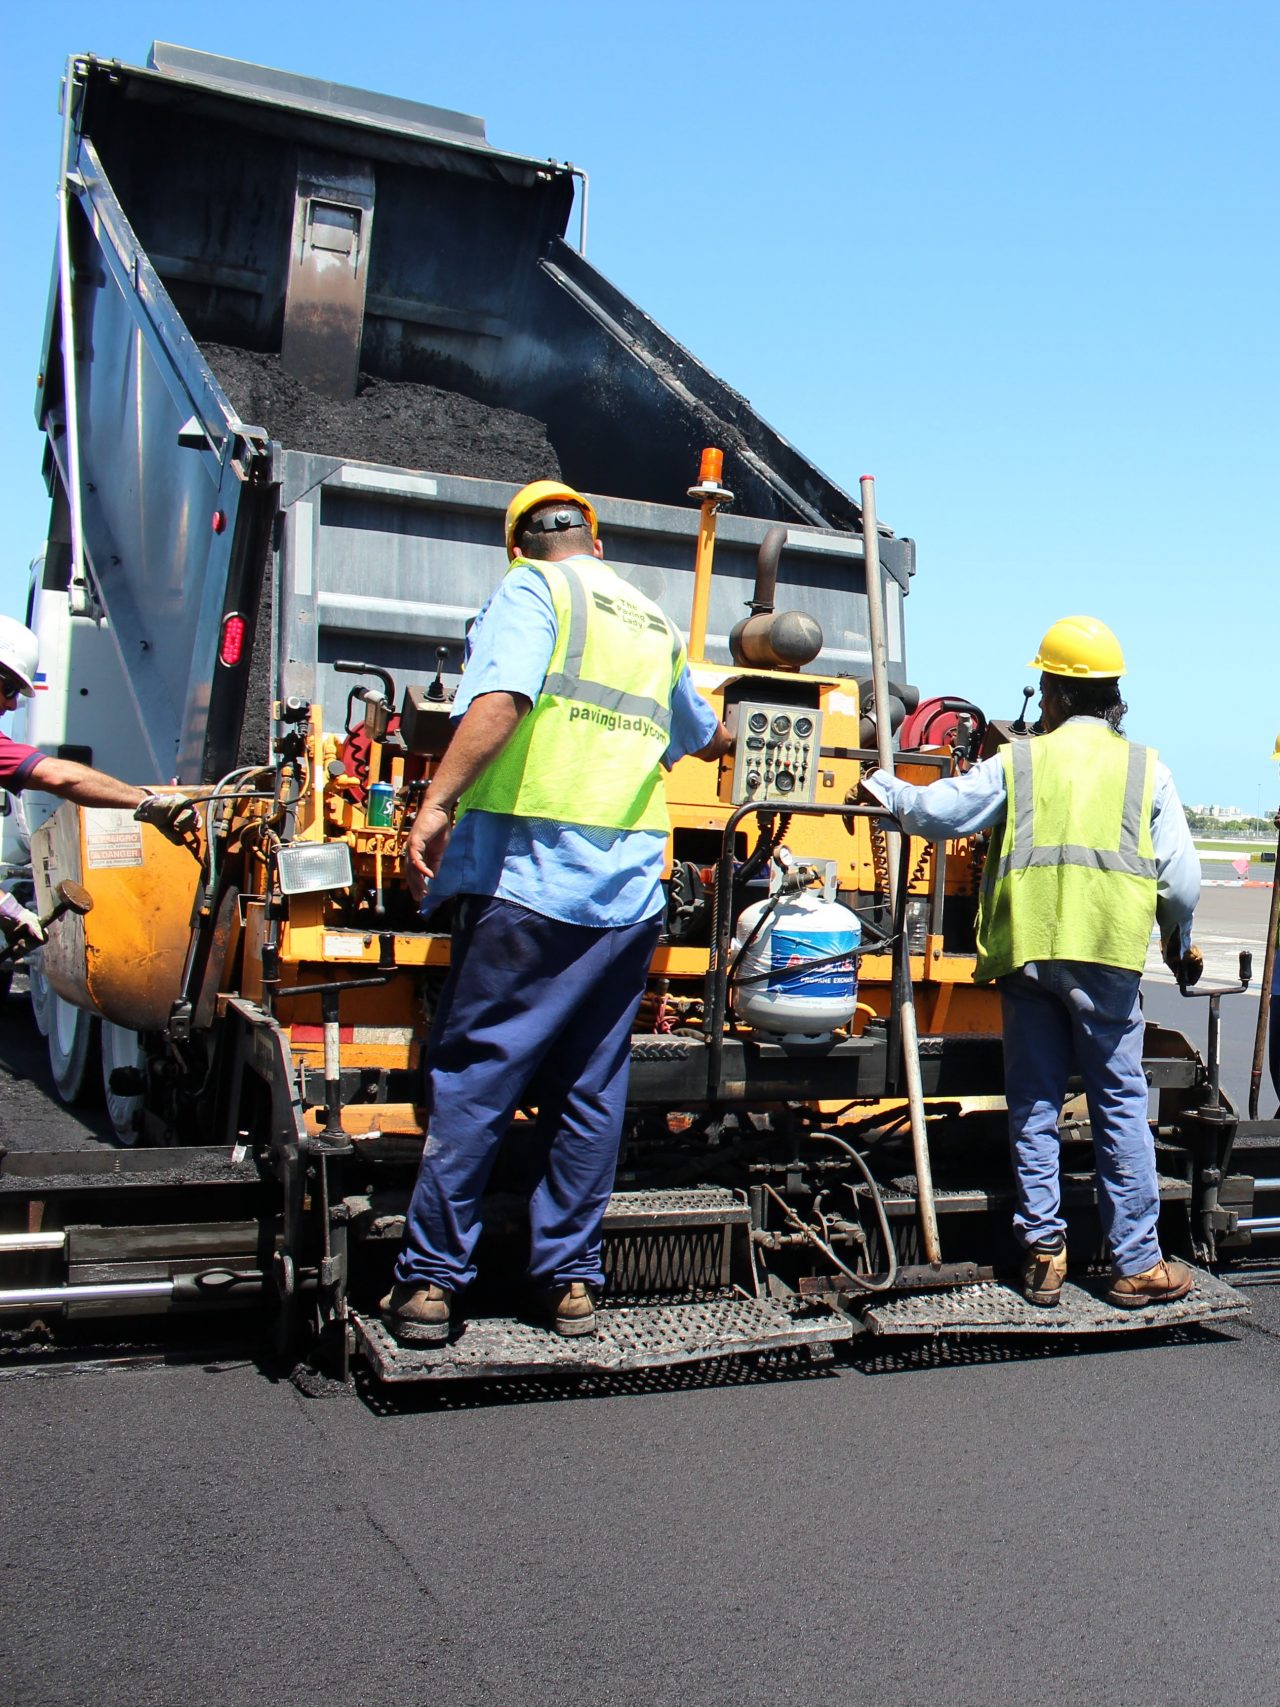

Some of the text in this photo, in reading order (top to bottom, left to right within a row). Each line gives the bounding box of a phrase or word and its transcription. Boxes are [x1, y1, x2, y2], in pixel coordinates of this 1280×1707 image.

[620, 599, 638, 611] The
[622, 614, 643, 628] Lady
[102, 850, 138, 859] DANGER
